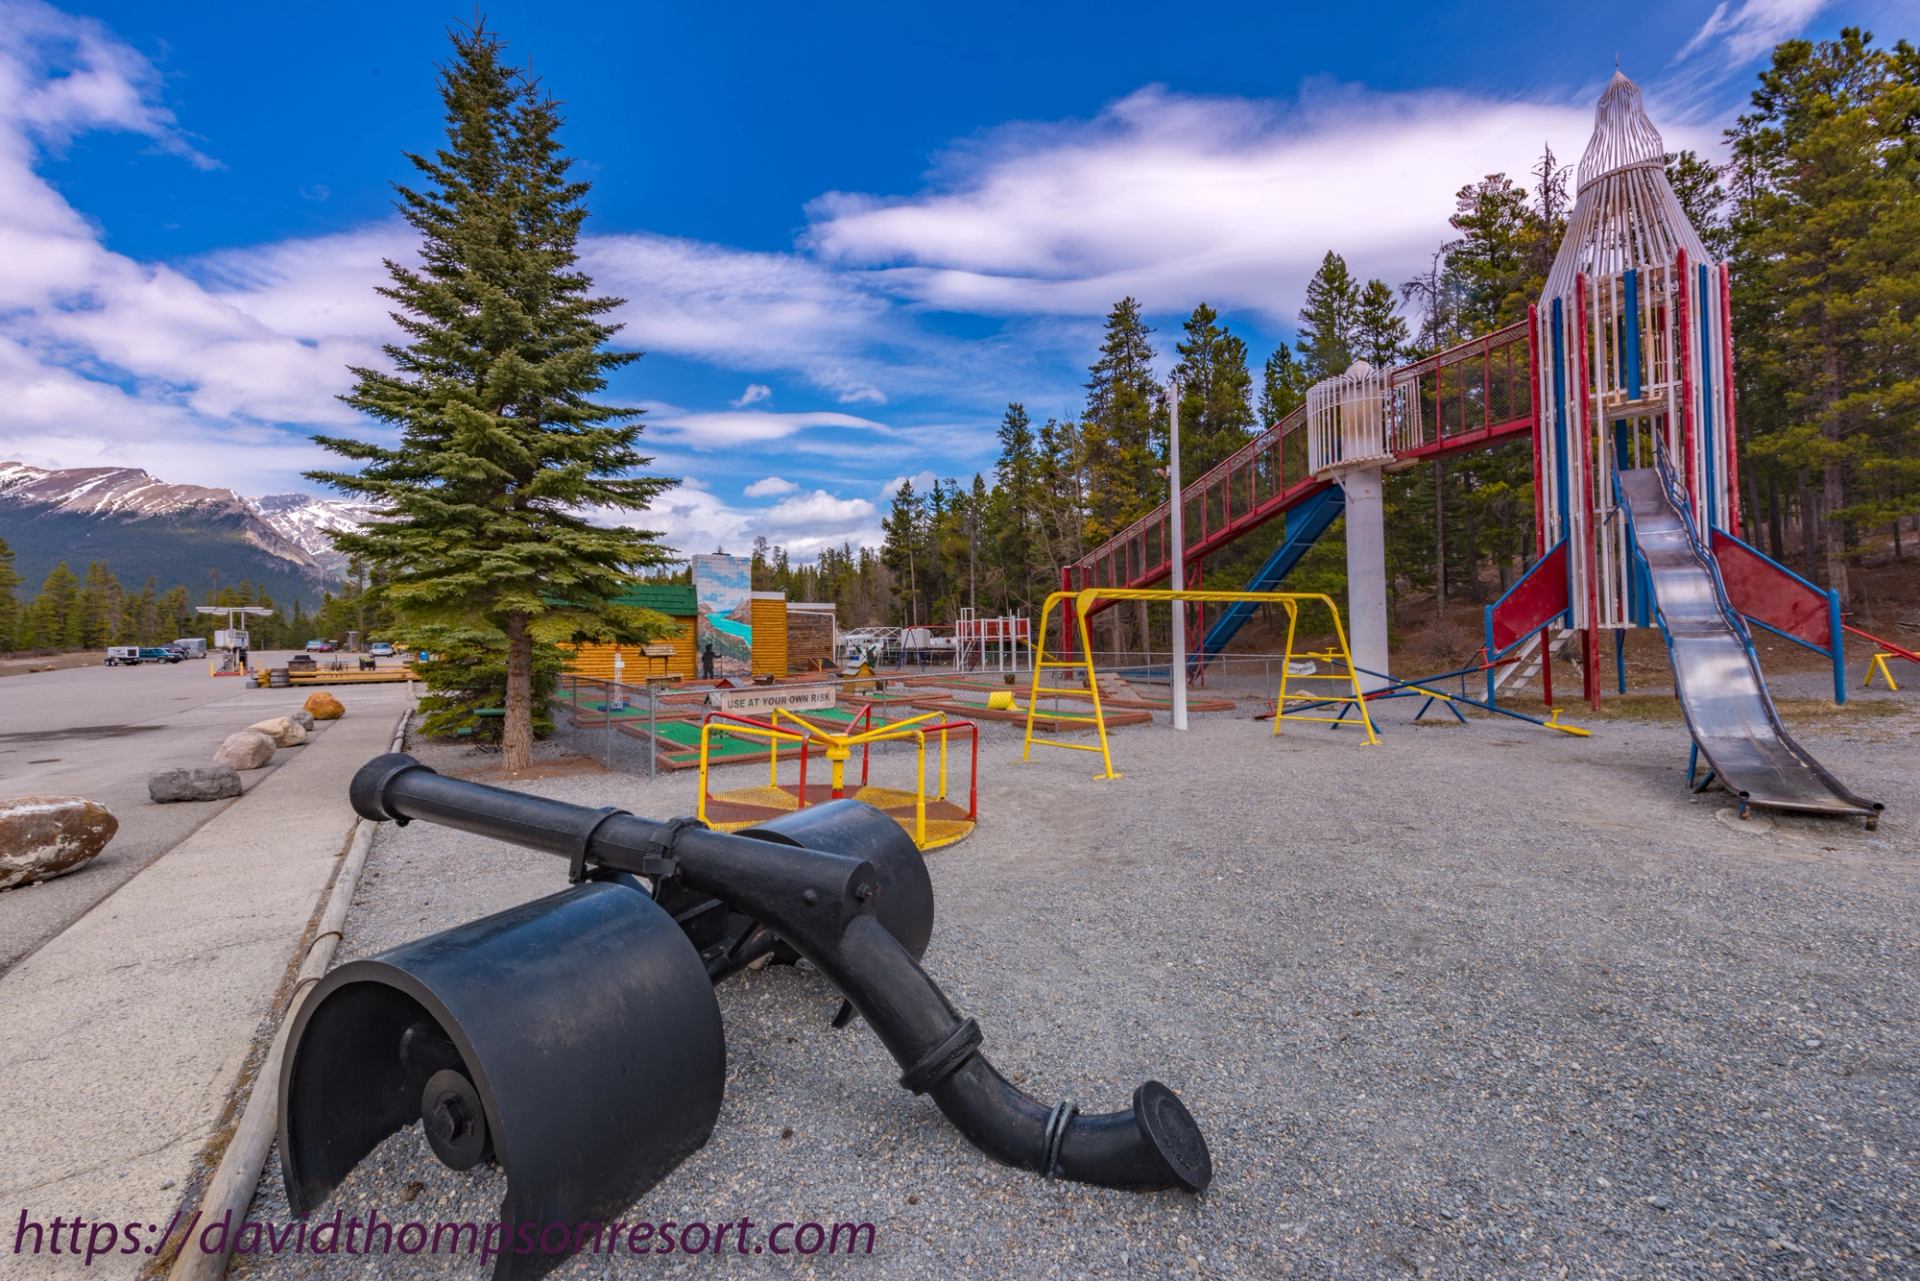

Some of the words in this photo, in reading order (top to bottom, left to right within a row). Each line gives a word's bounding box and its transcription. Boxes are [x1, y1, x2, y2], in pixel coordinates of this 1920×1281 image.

[727, 699, 745, 709] USE
[748, 698, 759, 708] AT
[762, 696, 788, 706] YOUR
[789, 694, 809, 704] OWN
[811, 692, 831, 703] RISK
